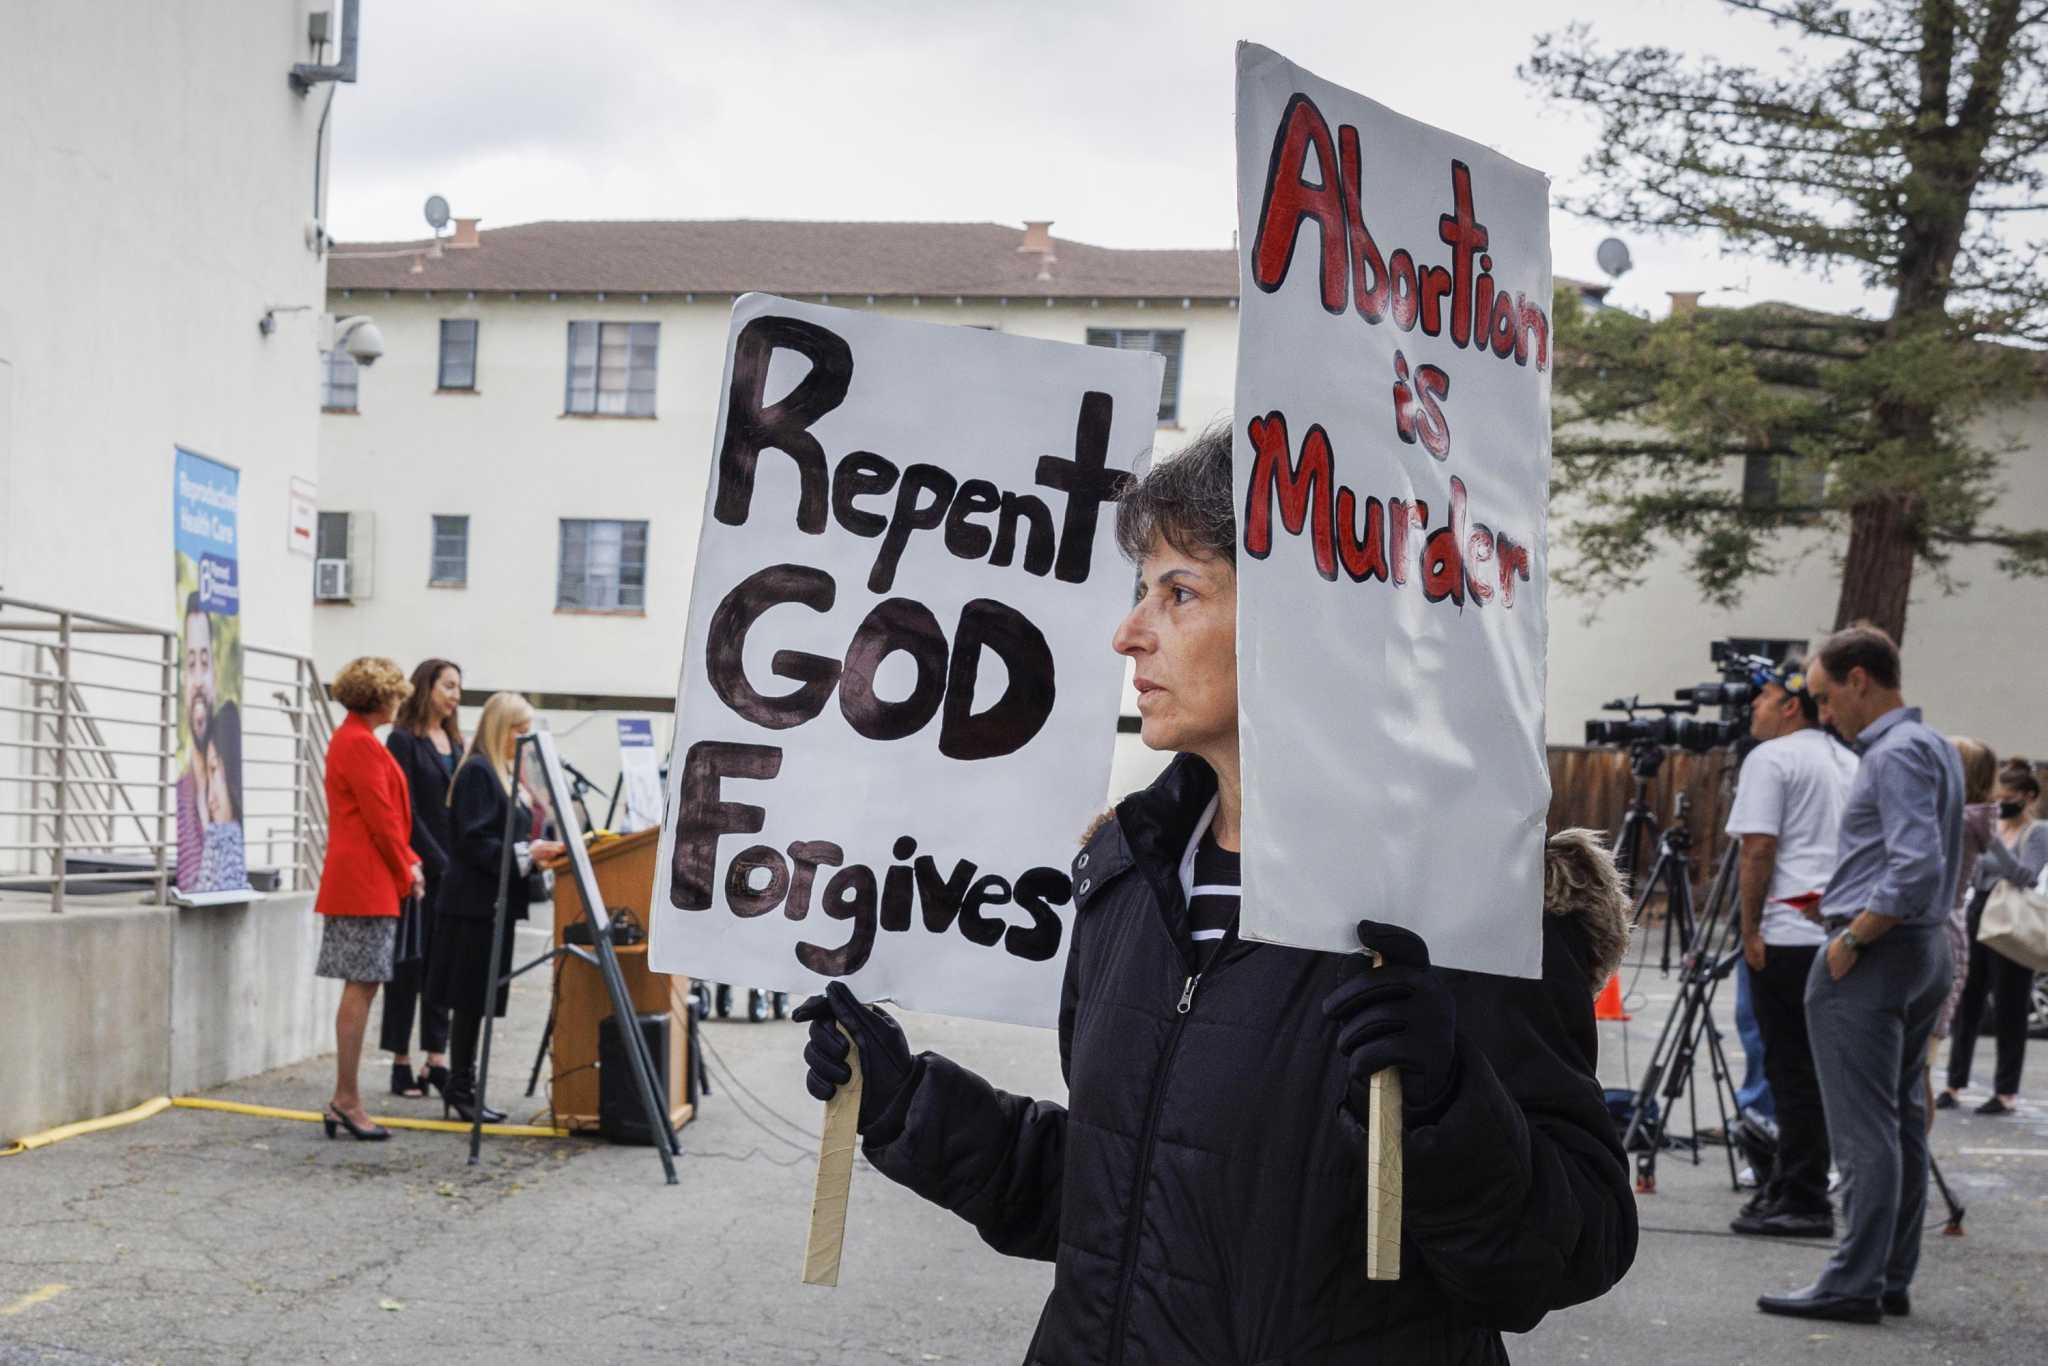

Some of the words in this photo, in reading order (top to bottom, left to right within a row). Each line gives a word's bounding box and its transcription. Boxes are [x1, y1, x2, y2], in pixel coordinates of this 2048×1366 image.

[1252, 92, 1549, 372] Abortion
[713, 314, 1138, 594] Repent
[1243, 410, 1530, 609] Murder
[1393, 349, 1450, 462] is
[706, 563, 1056, 760] GOD
[670, 740, 1073, 975] Forgives
